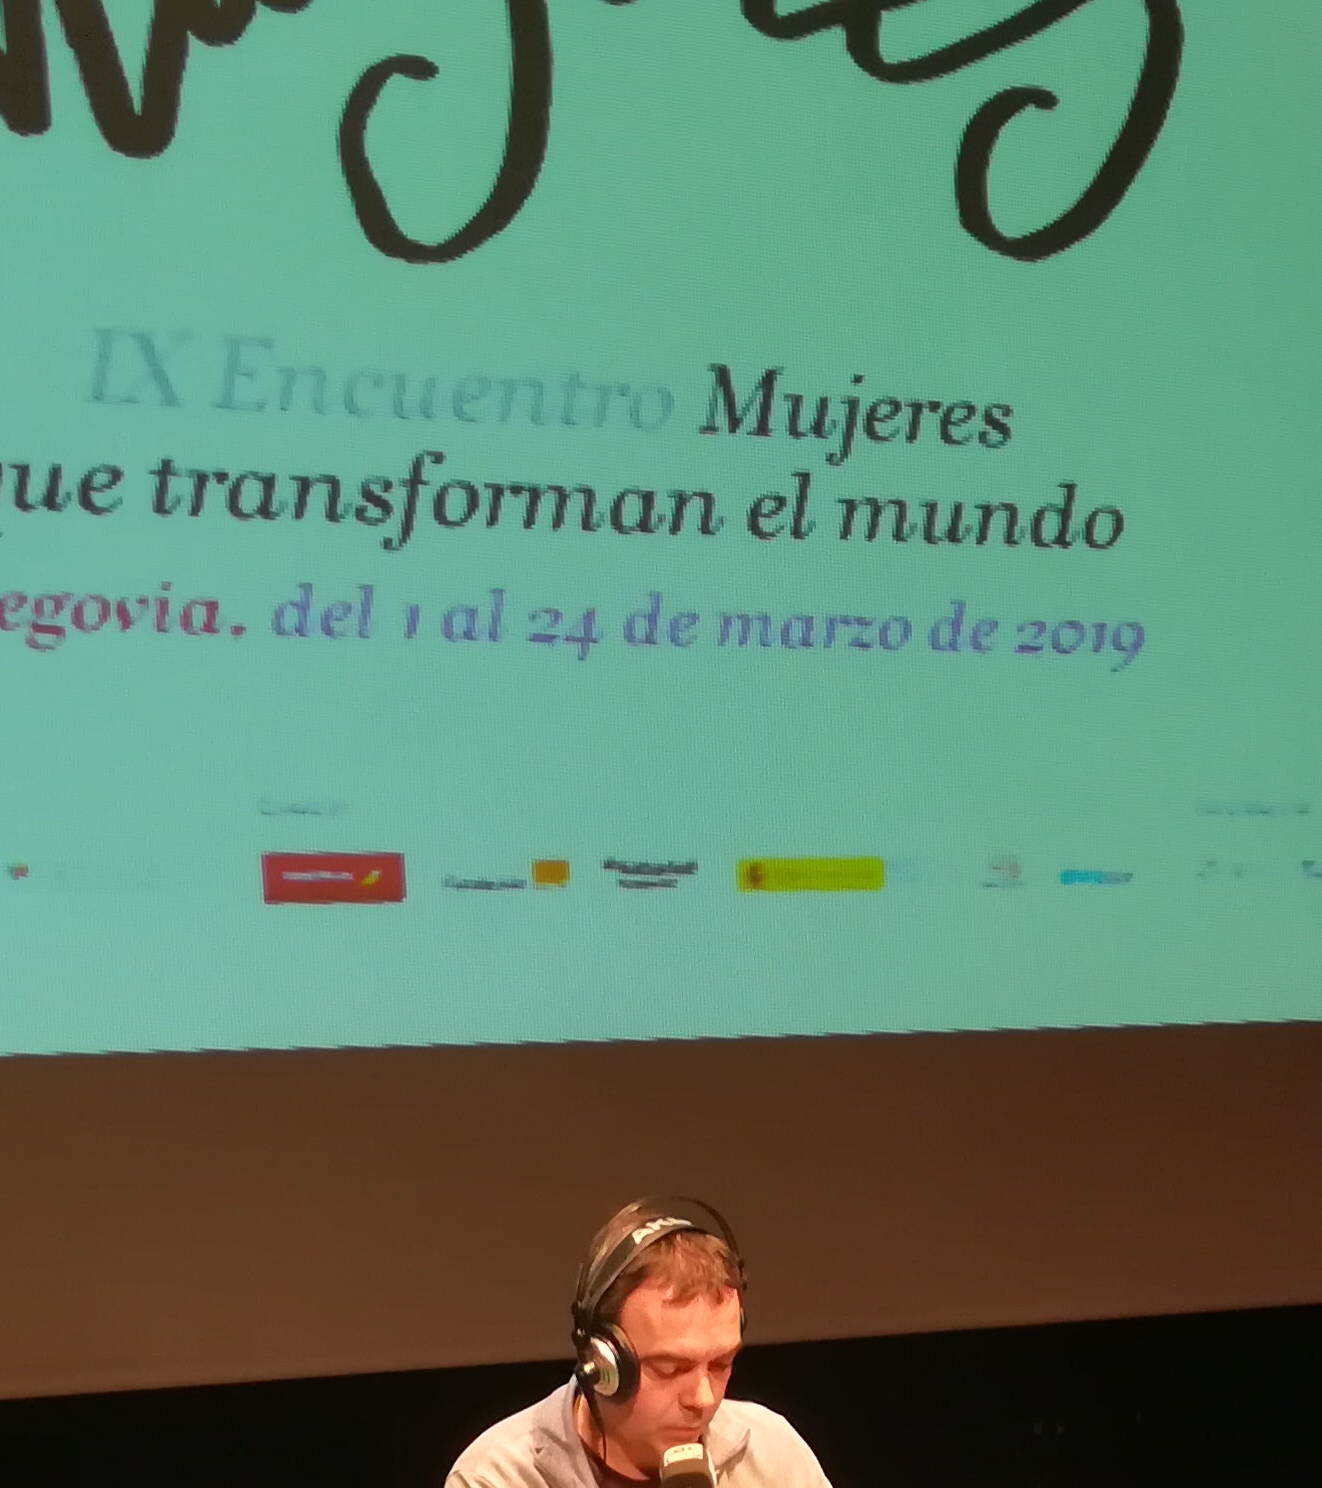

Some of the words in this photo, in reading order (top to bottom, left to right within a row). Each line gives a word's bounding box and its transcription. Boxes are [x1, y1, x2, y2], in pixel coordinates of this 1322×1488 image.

[86, 327, 193, 408] IX
[211, 331, 675, 432] Encuentro
[698, 362, 1014, 466] Mujeres
[146, 449, 725, 553] transforman
[745, 470, 816, 541] el
[835, 479, 1125, 550] mundo
[270, 581, 376, 641] del
[439, 587, 507, 643] al
[527, 605, 603, 662] 24
[622, 590, 700, 649] de
[717, 608, 914, 653] marzo
[927, 599, 1000, 655] de
[1012, 617, 1147, 673] 2019
